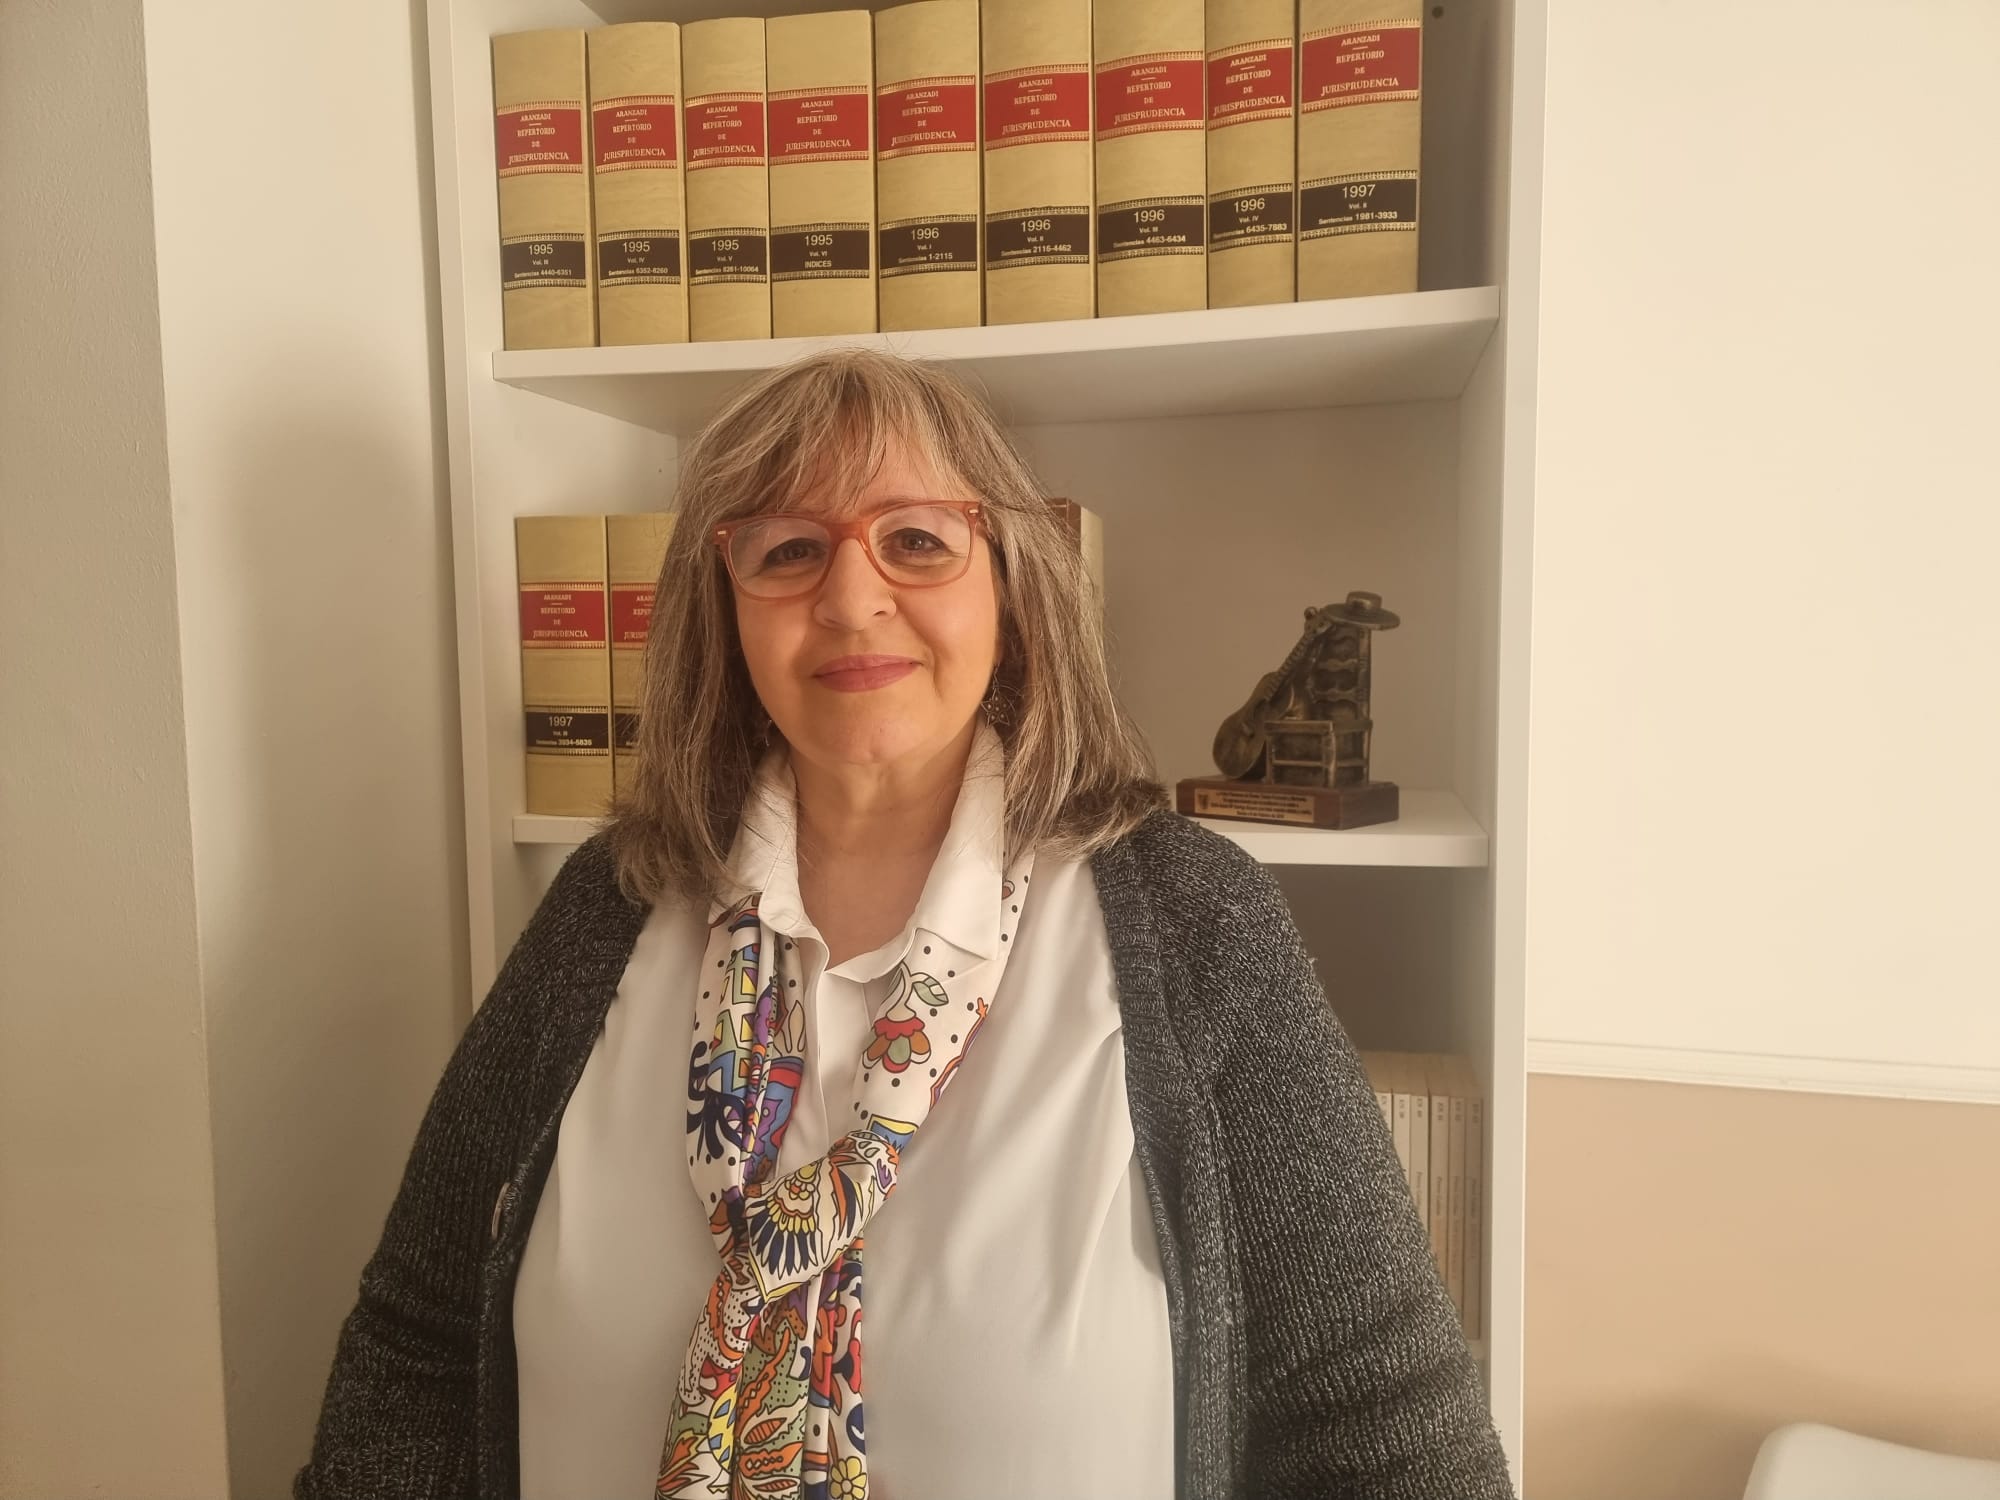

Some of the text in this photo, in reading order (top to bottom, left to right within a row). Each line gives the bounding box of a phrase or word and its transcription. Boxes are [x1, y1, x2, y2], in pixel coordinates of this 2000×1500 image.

[1341, 34, 1380, 47] ARANZADI
[1230, 54, 1267, 68] ARANZADI
[1336, 50, 1385, 64] REPERTORIO
[1131, 66, 1167, 77] ARANZADI
[1226, 69, 1271, 85] REPERTORIO
[1354, 67, 1366, 75] DE
[1018, 78, 1053, 89] ARANZADI
[1126, 82, 1171, 95] REPERTORIO
[1321, 77, 1399, 97] JURISPRUDENCIA
[906, 91, 939, 100] ARANZADI
[1243, 86, 1253, 94] DE
[801, 100, 834, 109] ARANZADI
[1014, 93, 1057, 105] REPERTORIO
[1144, 97, 1154, 105] DE
[706, 105, 738, 115] ARANZADI
[902, 105, 943, 117] REPERTORIO
[1030, 108, 1040, 116] DE
[1214, 96, 1286, 116] JURISPRUDENCIA
[520, 113, 551, 122] ARANZADI
[616, 109, 647, 118] ARANZADI
[797, 114, 838, 124] REPERTORIO
[1114, 107, 1185, 125] JURISPRUDENCIA
[612, 123, 652, 134] REPERTORIO
[702, 120, 742, 130] REPERTORIO
[1002, 120, 1071, 135] JURISPRUDENCIA
[517, 128, 555, 137] REPERTORIO
[717, 133, 726, 141] DE
[891, 131, 957, 147] JURISPRUDENCIA
[693, 145, 756, 159] JURISPRUDENCIA
[785, 140, 851, 153] JURISPRUDENCIA
[508, 151, 569, 164] JURISPRUDENCIA
[603, 148, 666, 161] JURISPRUDENCIA
[1342, 184, 1376, 199] 1997
[1234, 198, 1265, 213] 1996
[1133, 209, 1165, 224] 1996
[1355, 211, 1398, 221] 1981-3933
[1020, 219, 1051, 233] 1996
[911, 227, 940, 241] 1996
[711, 239, 740, 252] 1995
[804, 234, 833, 247] 1995
[528, 244, 554, 256] 1995
[622, 241, 650, 253] 1995
[928, 252, 953, 261] 1-2115
[533, 630, 589, 639] JURISPRUDENCIA
[549, 716, 573, 727] 1997
